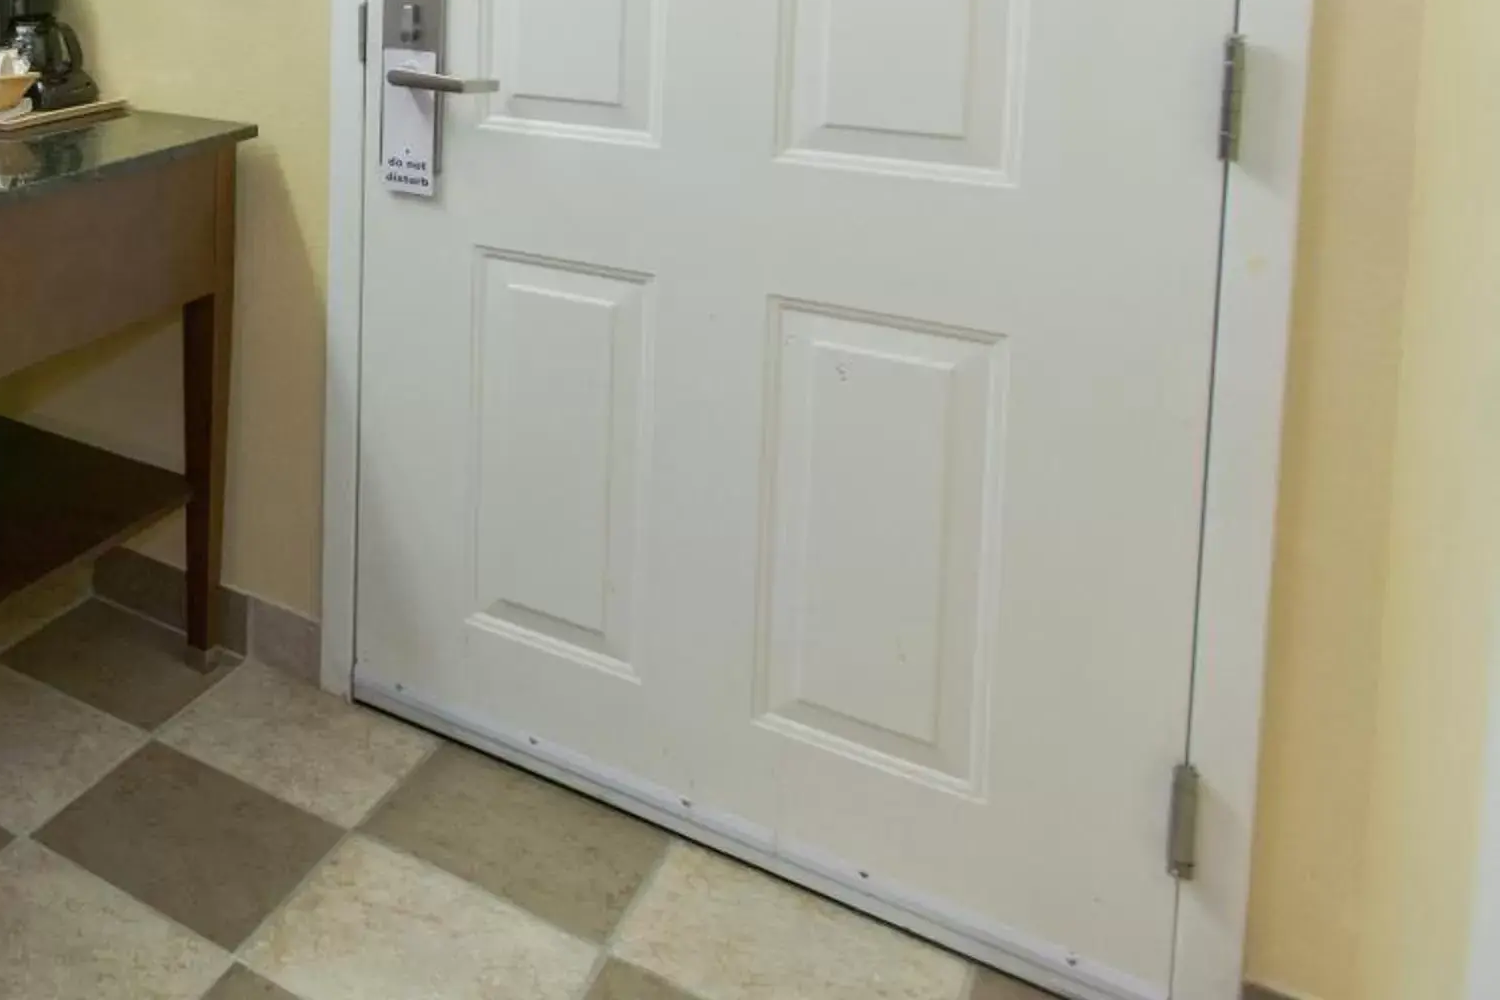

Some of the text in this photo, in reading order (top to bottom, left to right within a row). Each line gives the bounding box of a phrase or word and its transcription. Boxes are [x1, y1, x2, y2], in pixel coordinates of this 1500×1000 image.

[387, 156, 426, 171] do not
[385, 171, 429, 187] disturb
